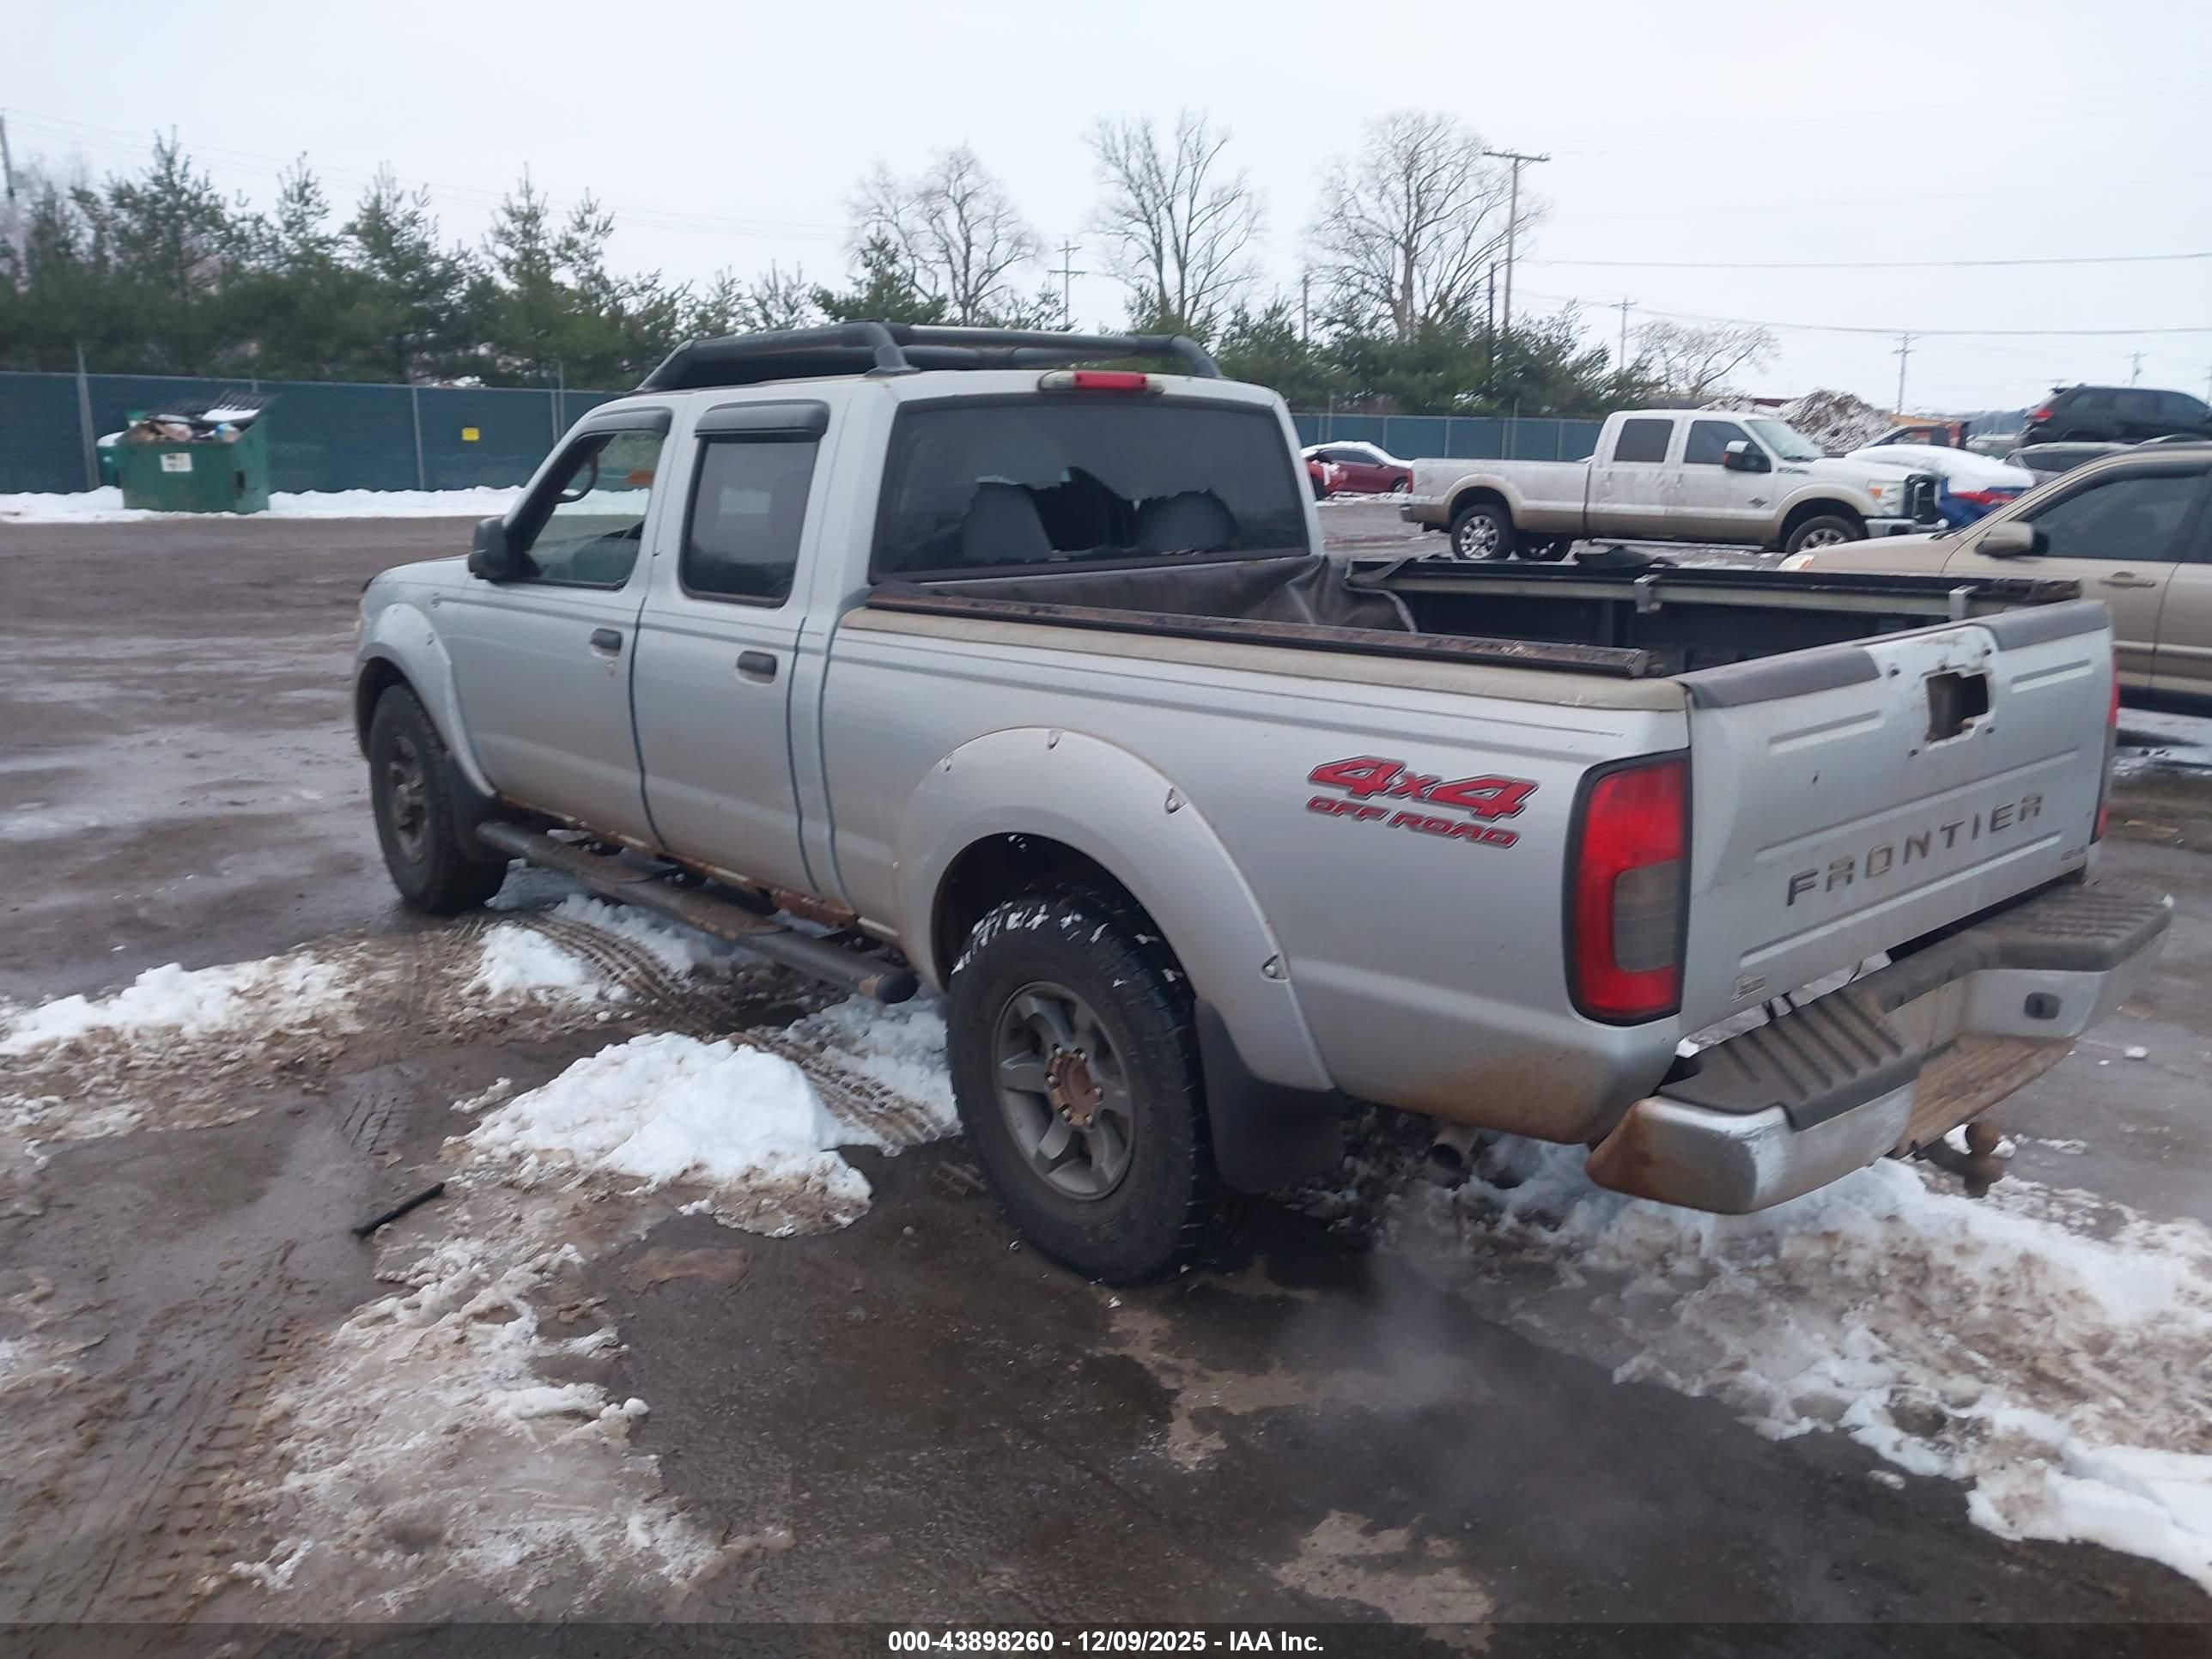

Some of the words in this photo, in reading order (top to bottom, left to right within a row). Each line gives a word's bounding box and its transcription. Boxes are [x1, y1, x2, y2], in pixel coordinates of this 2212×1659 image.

[1305, 795, 1390, 822] OFF
[1388, 811, 1520, 848] ROAD
[1307, 755, 1540, 822] 4x4
[1786, 792, 2044, 907] FRONTIER
